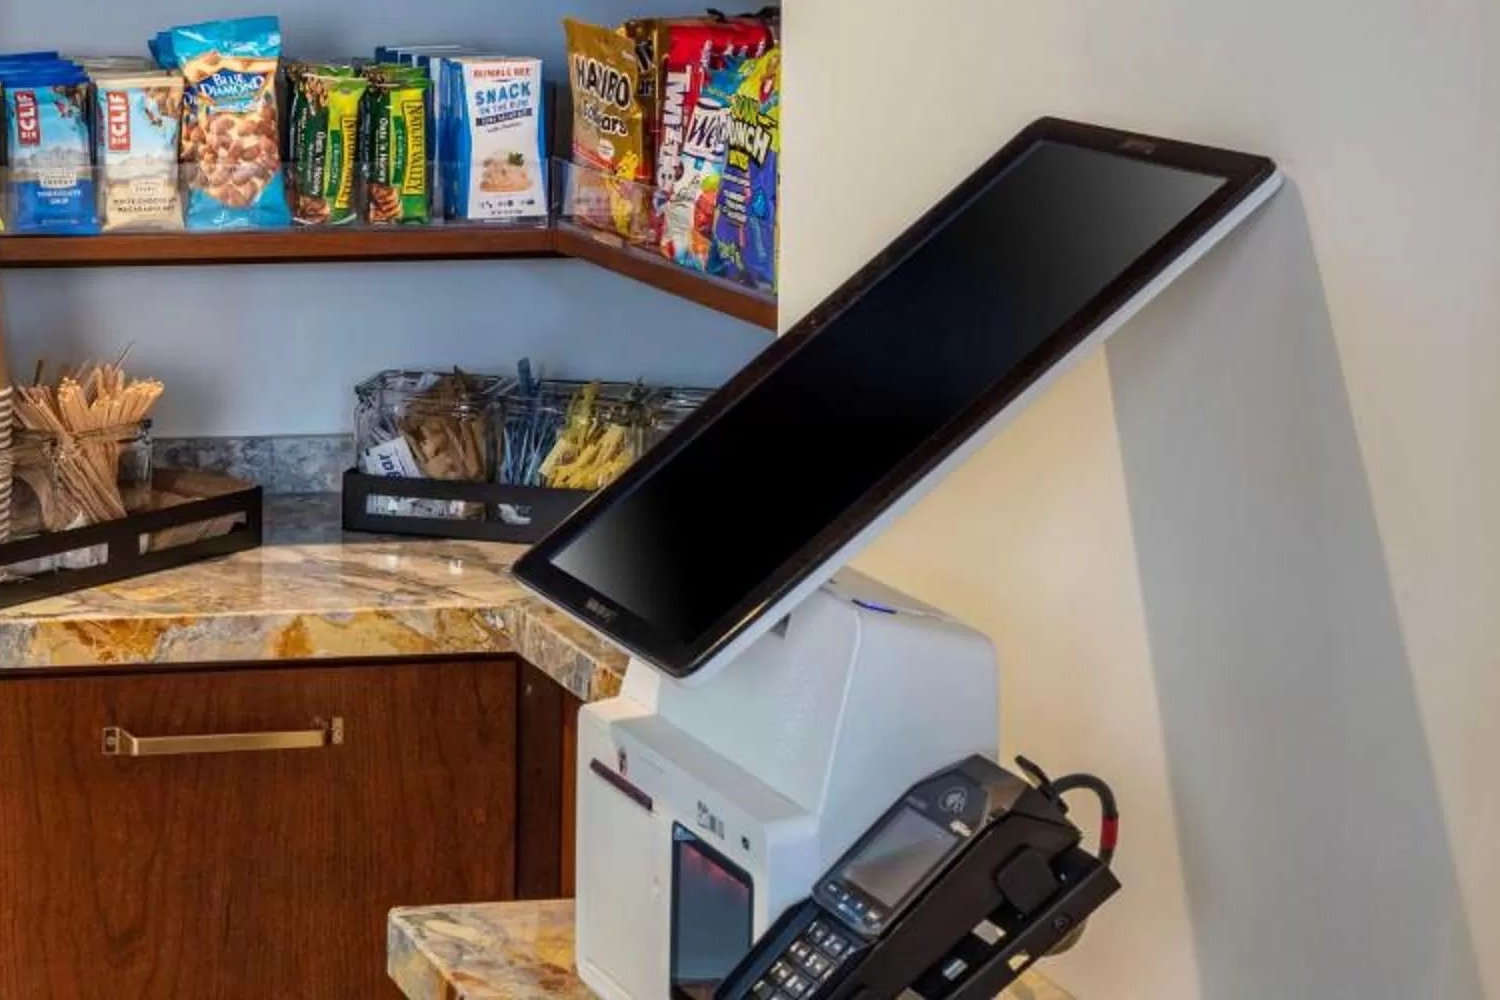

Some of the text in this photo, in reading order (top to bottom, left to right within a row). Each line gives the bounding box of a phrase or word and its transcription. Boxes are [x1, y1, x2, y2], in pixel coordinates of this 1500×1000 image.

[475, 81, 532, 106] SNACK
[16, 94, 37, 131] CLIF
[108, 94, 129, 135] CLIF
